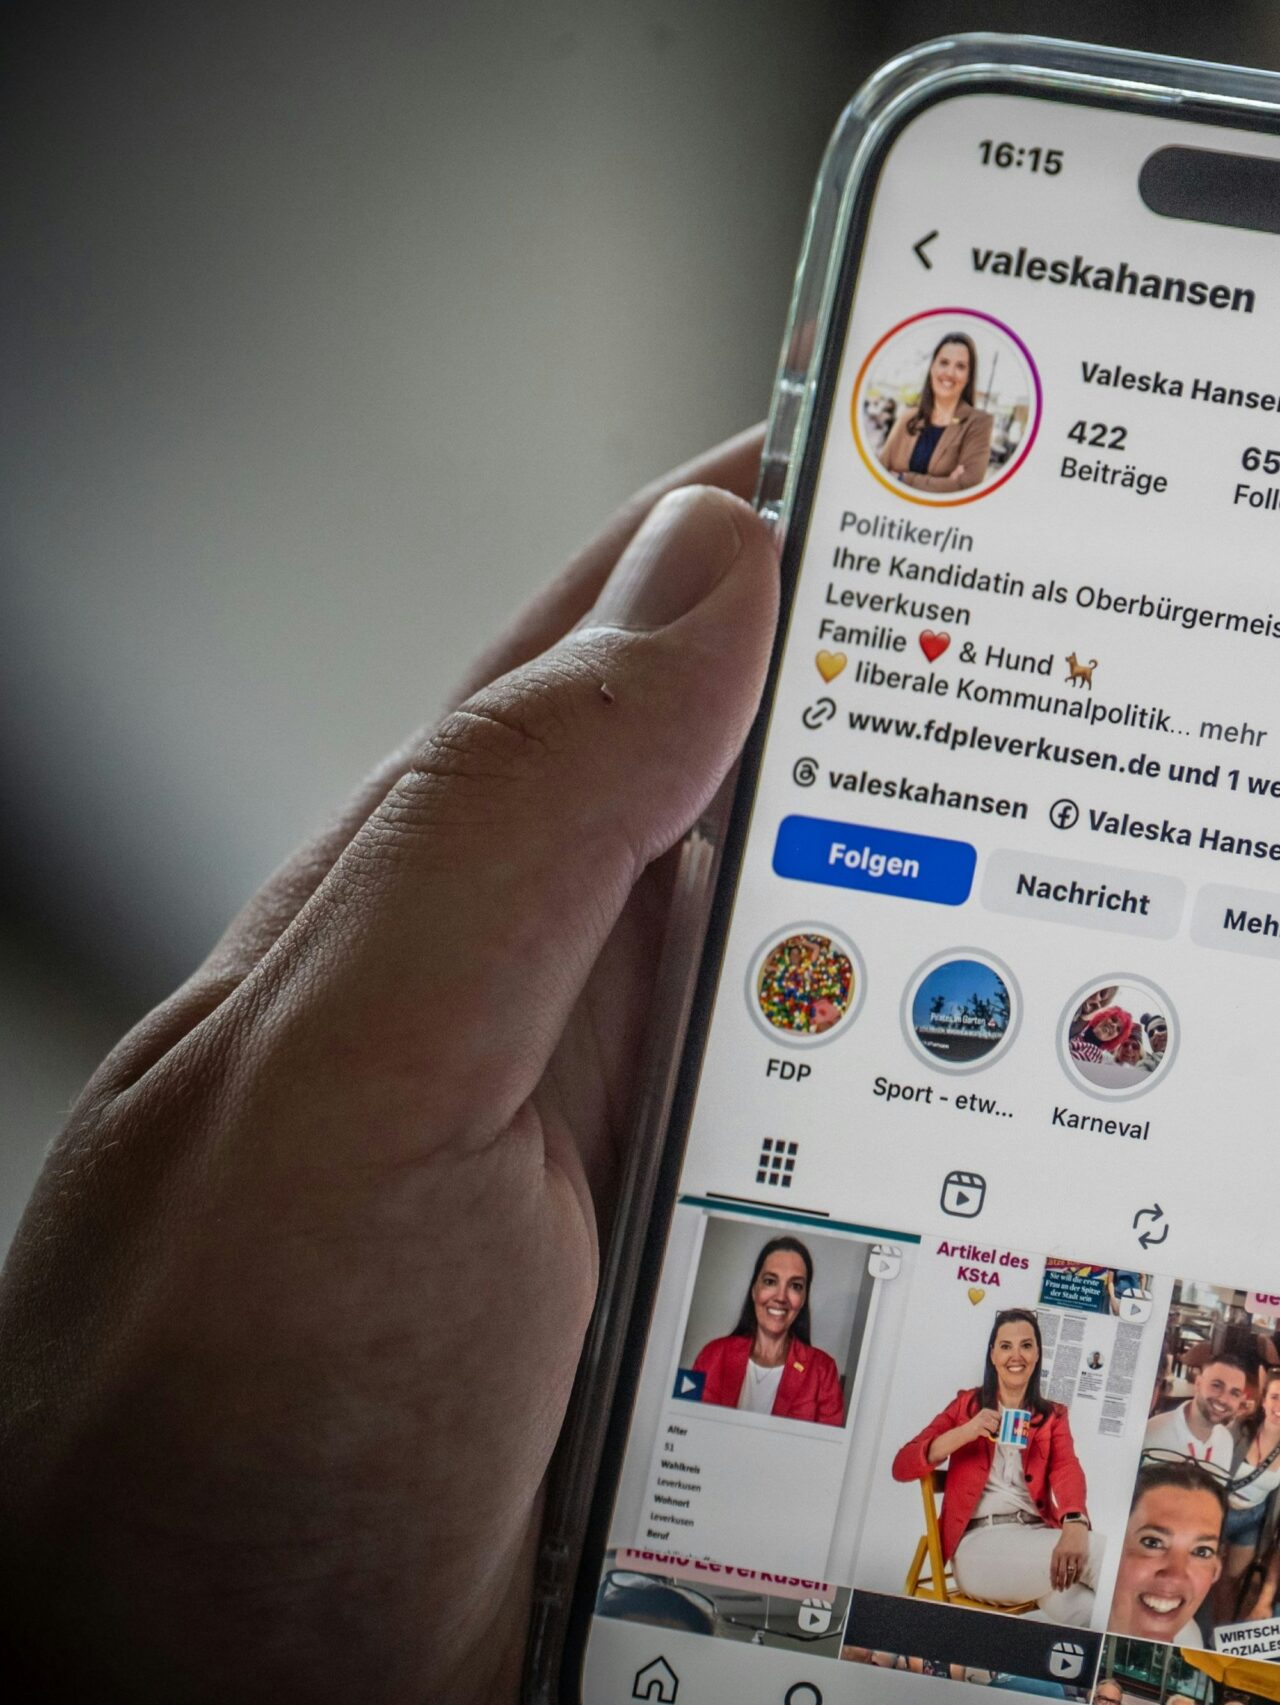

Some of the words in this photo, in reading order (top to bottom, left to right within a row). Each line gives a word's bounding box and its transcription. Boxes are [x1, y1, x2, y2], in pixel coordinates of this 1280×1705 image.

[979, 140, 1064, 176] 16:15
[972, 247, 1255, 313] valeskahansen
[1082, 361, 1184, 397] Valeska
[1067, 420, 1127, 451] 422
[1060, 456, 1168, 495] Beiträge
[840, 511, 973, 552] Politiker/in
[833, 547, 881, 574] Ihre
[889, 556, 1024, 597] Kandidatin
[1032, 580, 1068, 604] als
[826, 582, 970, 626] Leverkusen
[818, 618, 907, 652] Familie
[959, 641, 977, 664] &
[985, 645, 1054, 676] Hund
[855, 661, 949, 696] liberale
[1200, 722, 1267, 747] mehr
[849, 712, 1161, 778] www.fdpleverkusen.de
[1168, 764, 1220, 787] und
[1228, 770, 1240, 791] 1
[829, 771, 1028, 819] valeskahansen
[1089, 809, 1192, 846] Valeska
[828, 843, 920, 881] Folgen
[1016, 874, 1150, 915] Nachricht
[766, 1058, 811, 1082] FDP
[873, 1077, 933, 1104] Sport
[1052, 1107, 1150, 1140] Karneval
[936, 1241, 996, 1264] Artikel
[999, 1252, 1029, 1270] des
[957, 1266, 1000, 1287] KStA
[667, 1425, 688, 1436] Alter
[661, 1459, 700, 1474] Wahlkreis
[654, 1494, 690, 1508] Wohnort
[657, 1478, 701, 1492] Leverkusen
[646, 1528, 670, 1540] Beruf
[650, 1511, 694, 1527] Leverkusen
